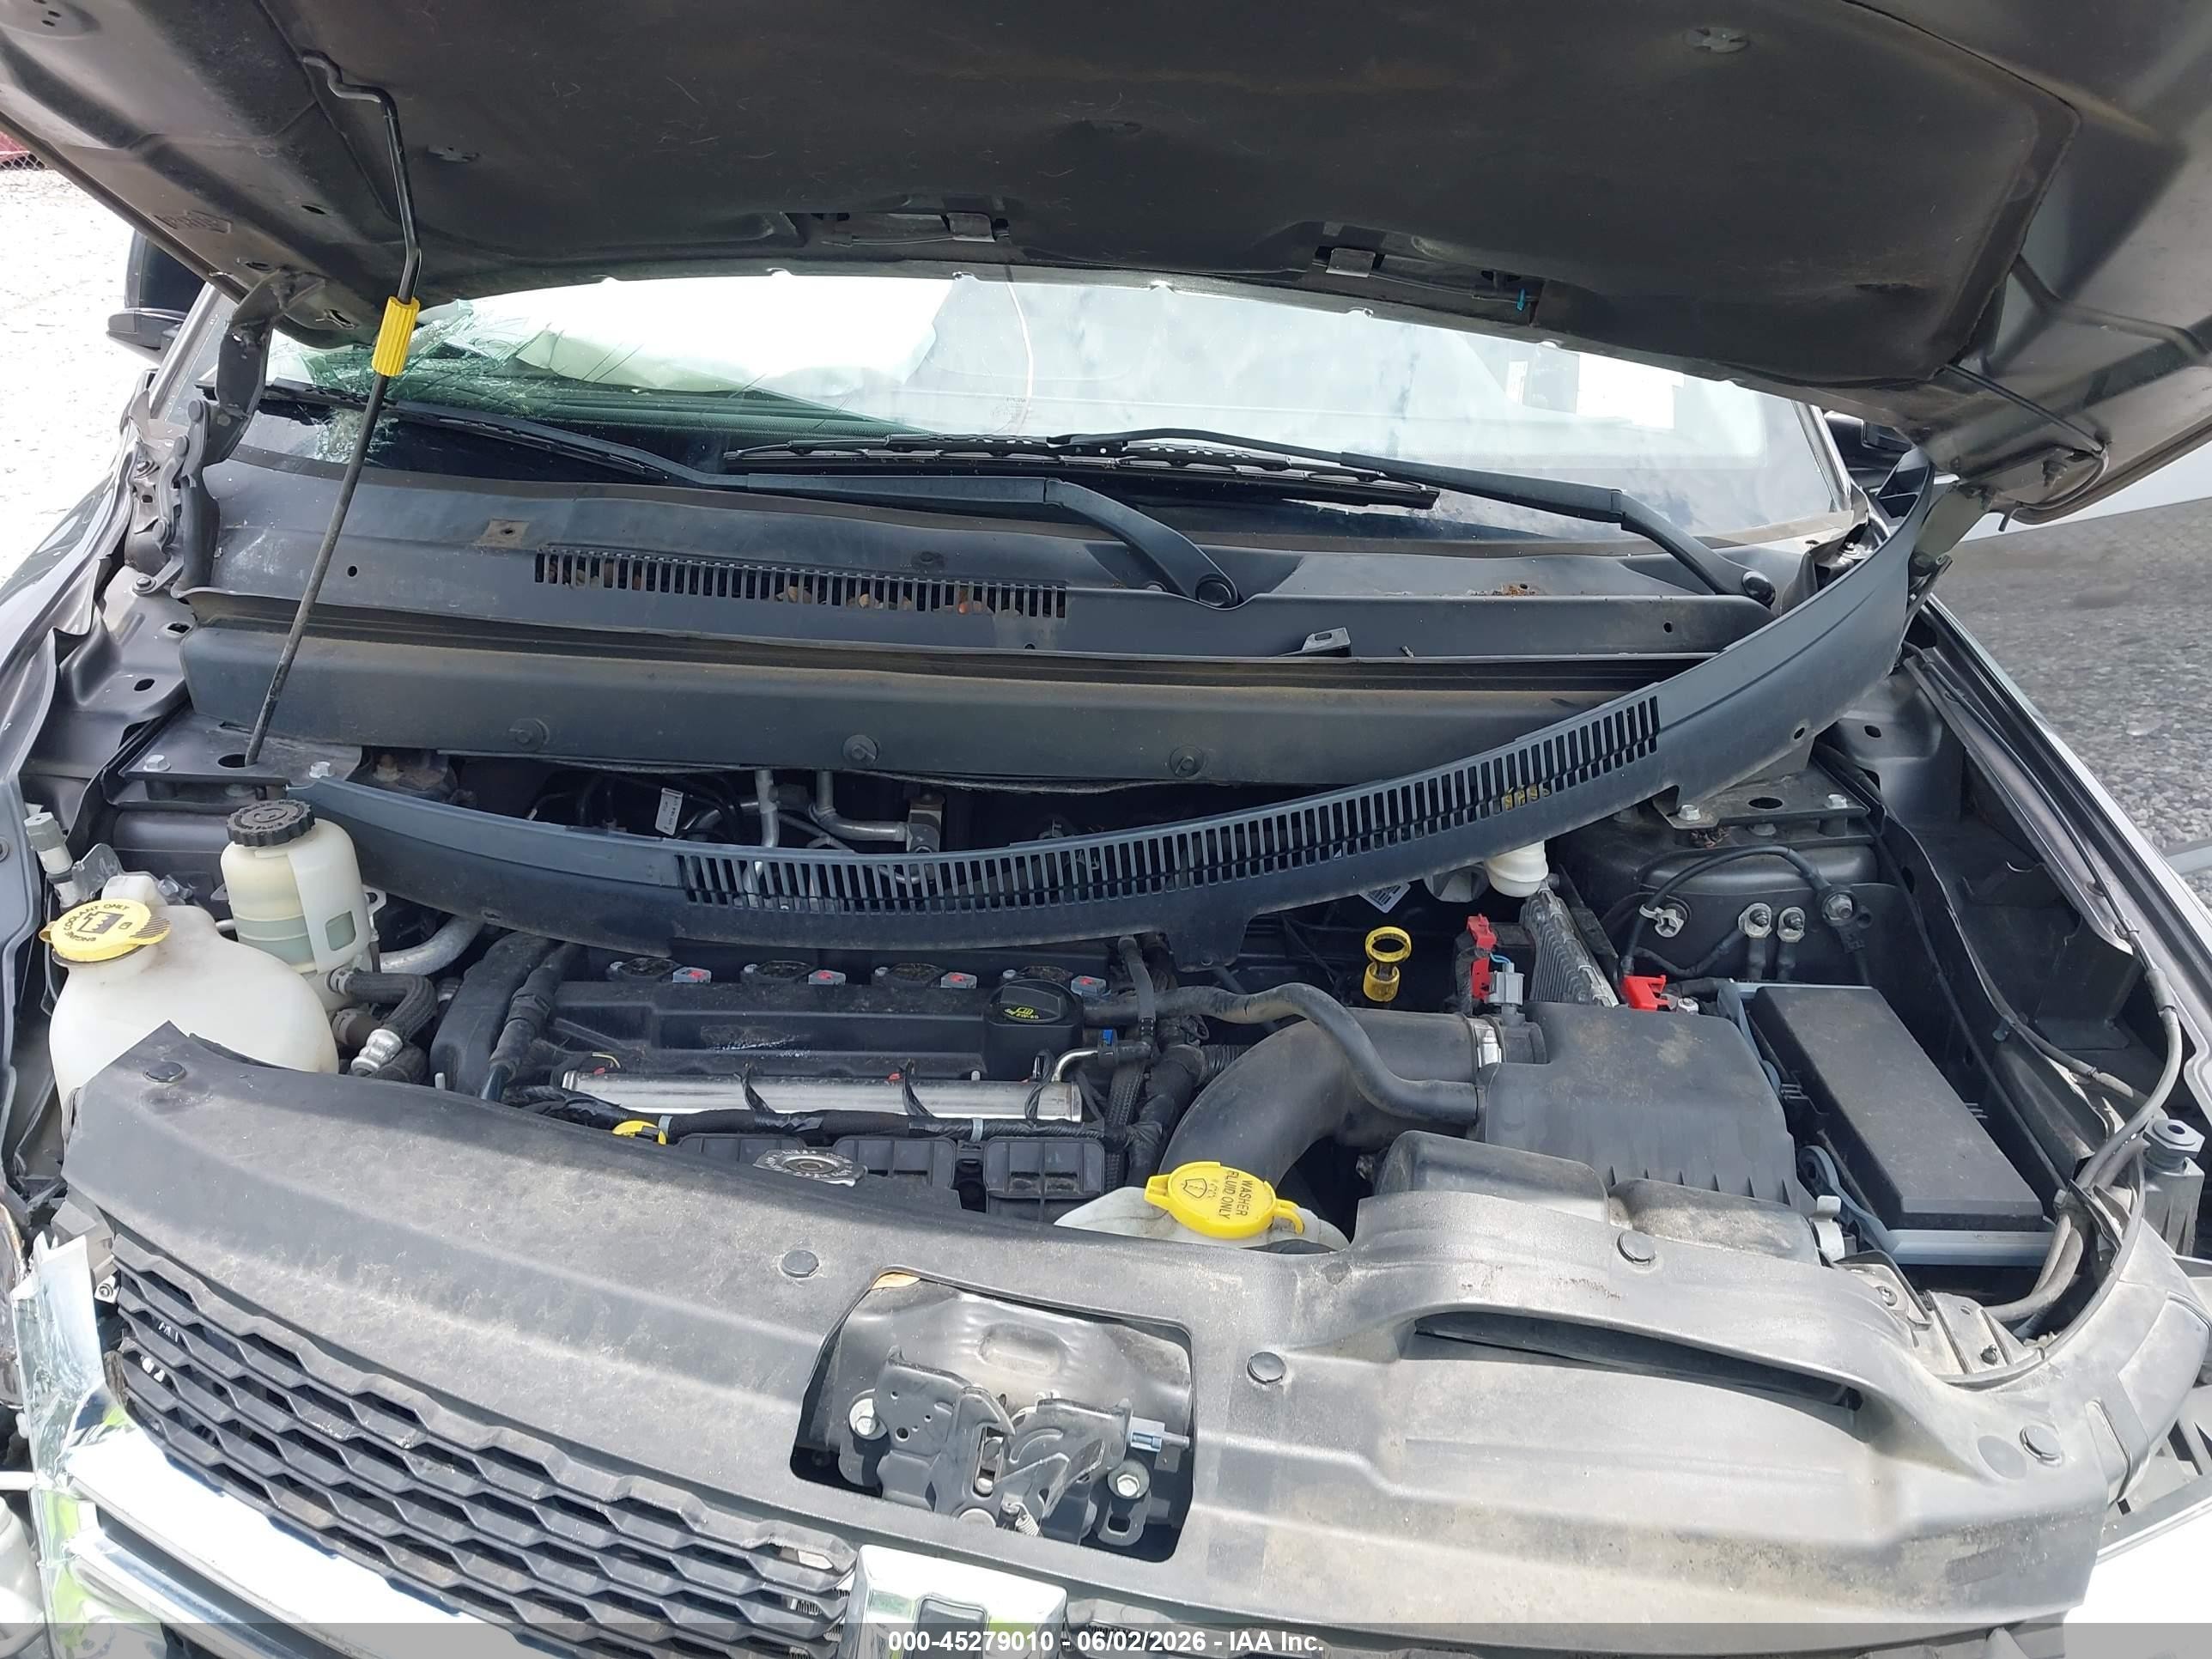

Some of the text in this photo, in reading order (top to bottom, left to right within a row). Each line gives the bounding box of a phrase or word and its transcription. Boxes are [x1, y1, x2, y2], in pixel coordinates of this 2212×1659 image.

[1218, 1170, 1239, 1219] FLUID ONLY
[1236, 1180, 1253, 1216] WASHER
